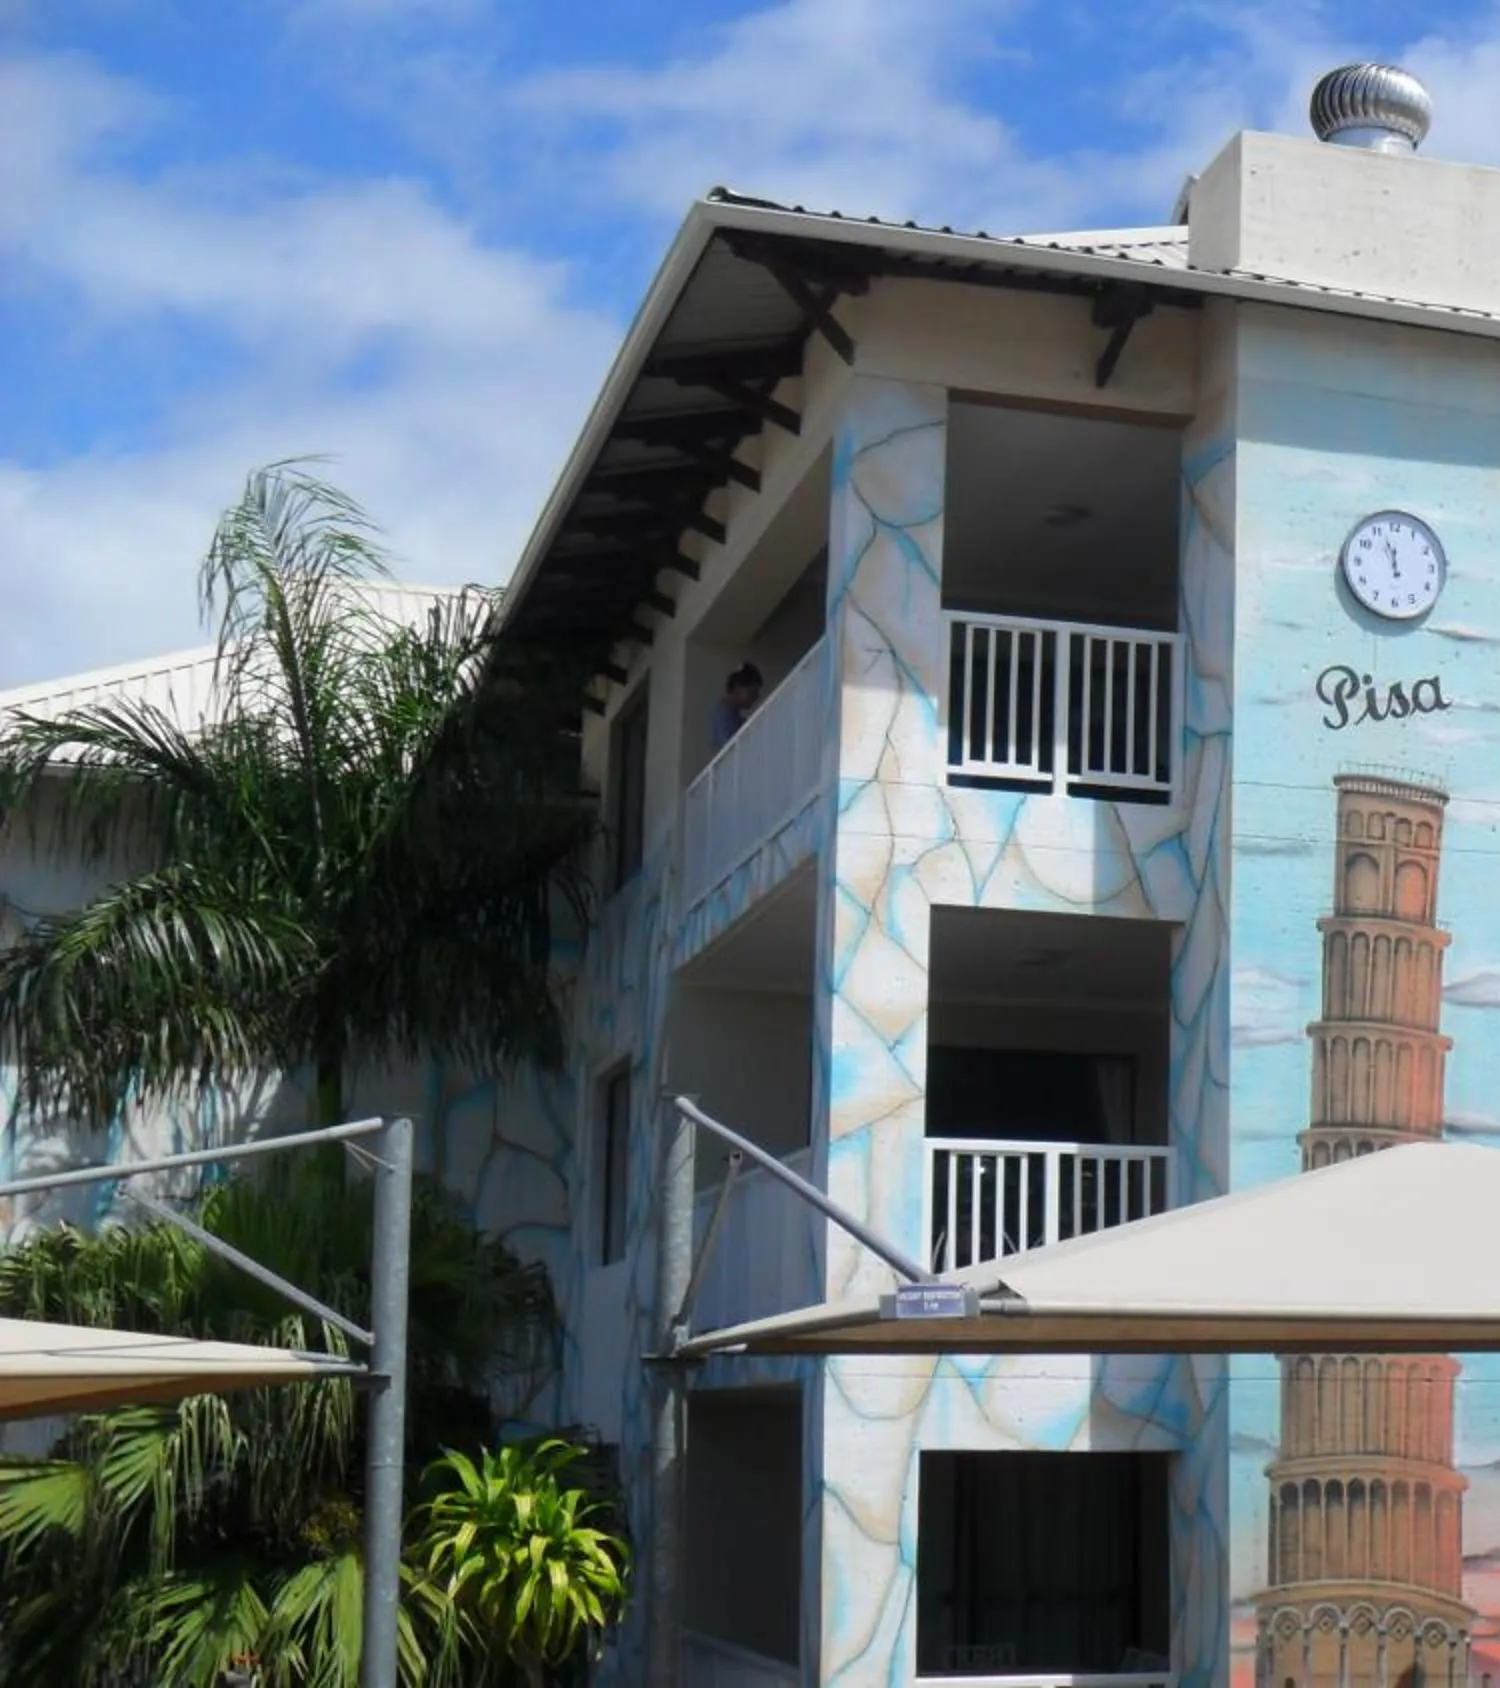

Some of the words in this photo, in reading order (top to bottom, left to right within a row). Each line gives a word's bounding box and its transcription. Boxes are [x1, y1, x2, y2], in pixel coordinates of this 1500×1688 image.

[1372, 526, 1381, 537] 11
[1389, 522, 1401, 533] 12
[1359, 539, 1372, 550] 10
[1315, 664, 1452, 730] Pisa
